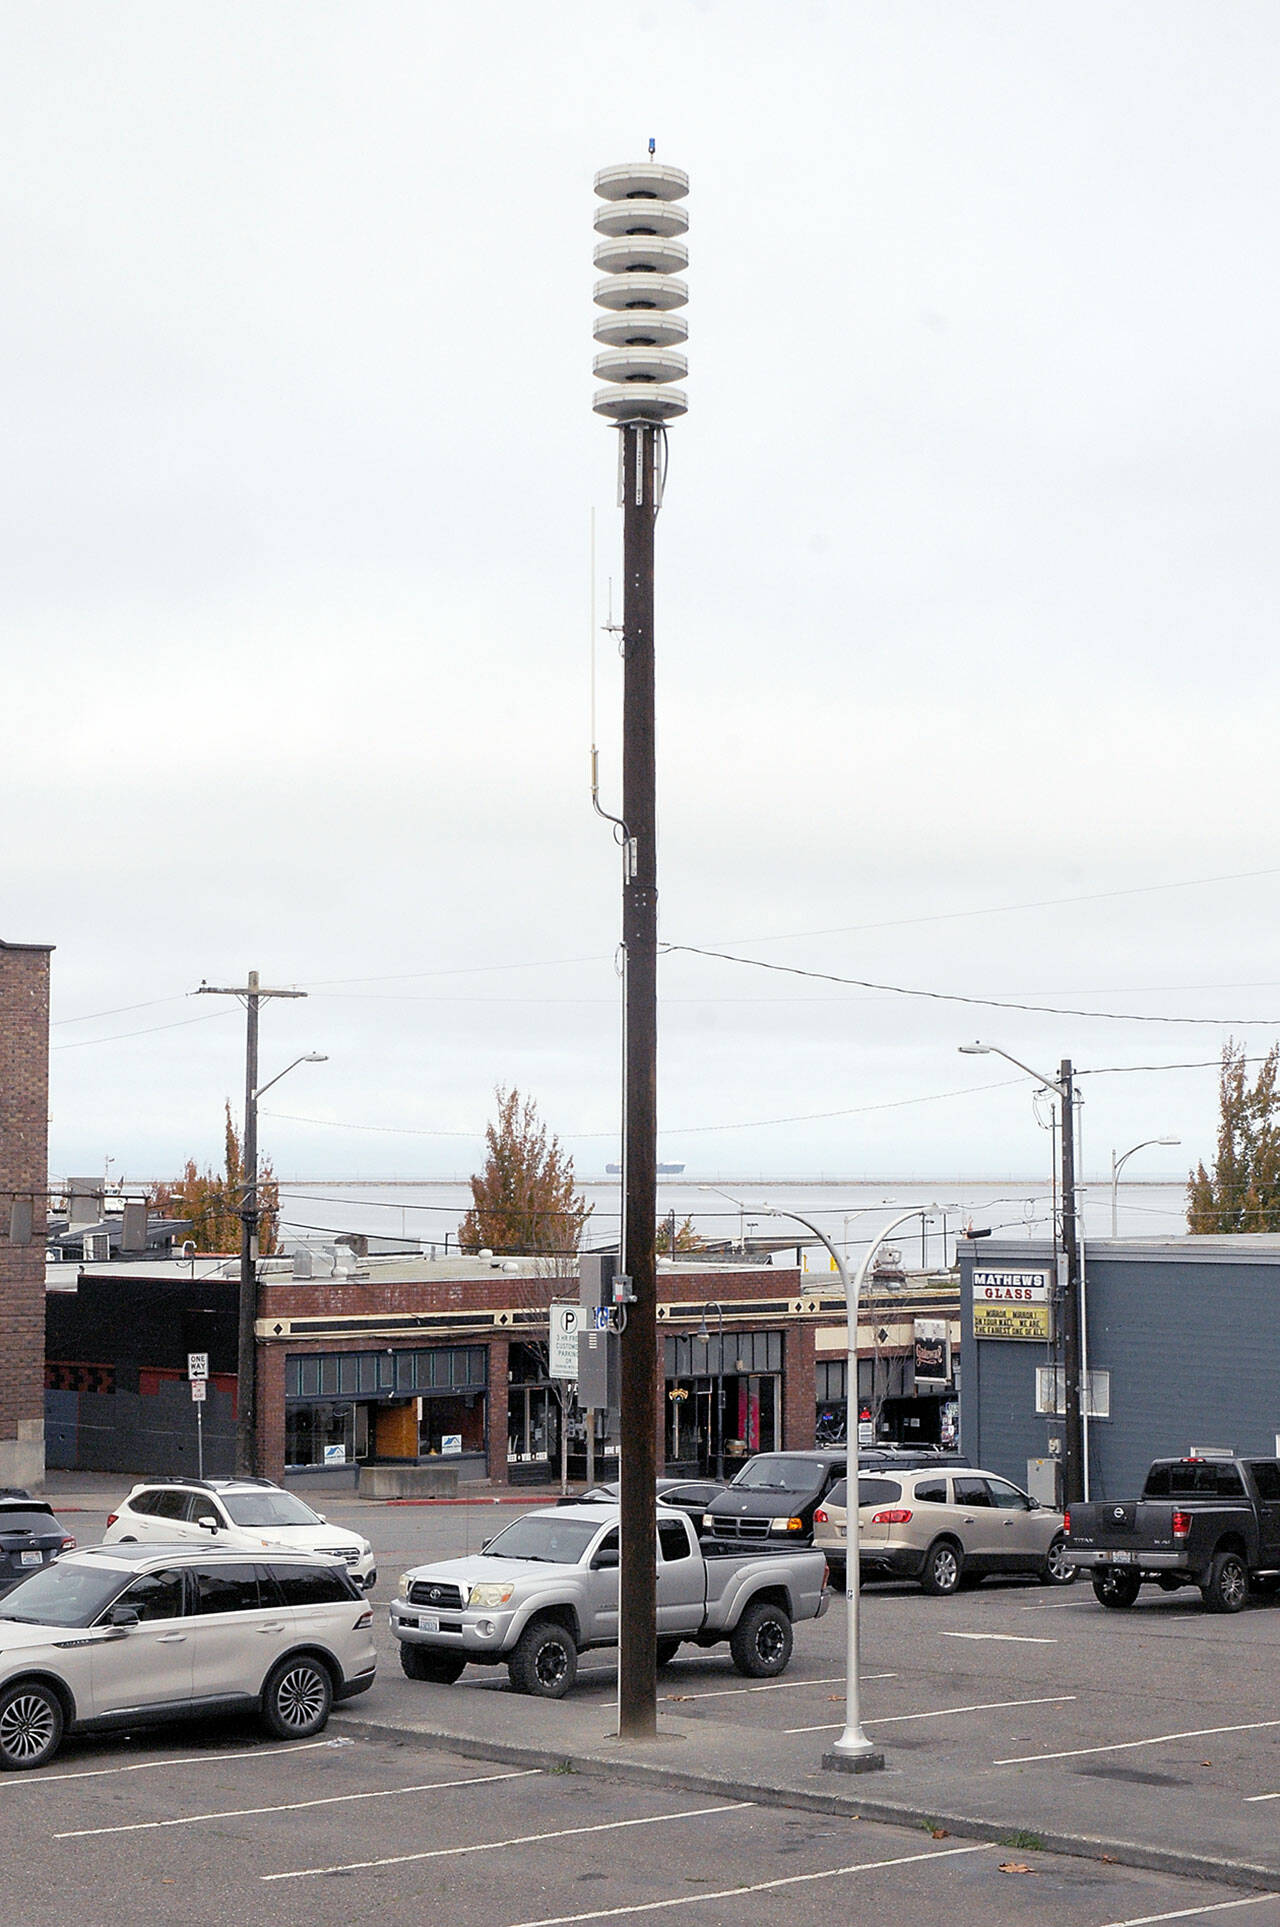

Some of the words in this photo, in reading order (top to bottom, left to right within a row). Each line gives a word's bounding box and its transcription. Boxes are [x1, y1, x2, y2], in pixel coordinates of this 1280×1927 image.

[974, 1274, 1042, 1286] MATHEWS
[985, 1288, 1032, 1299] GLASS
[565, 1312, 575, 1330] P
